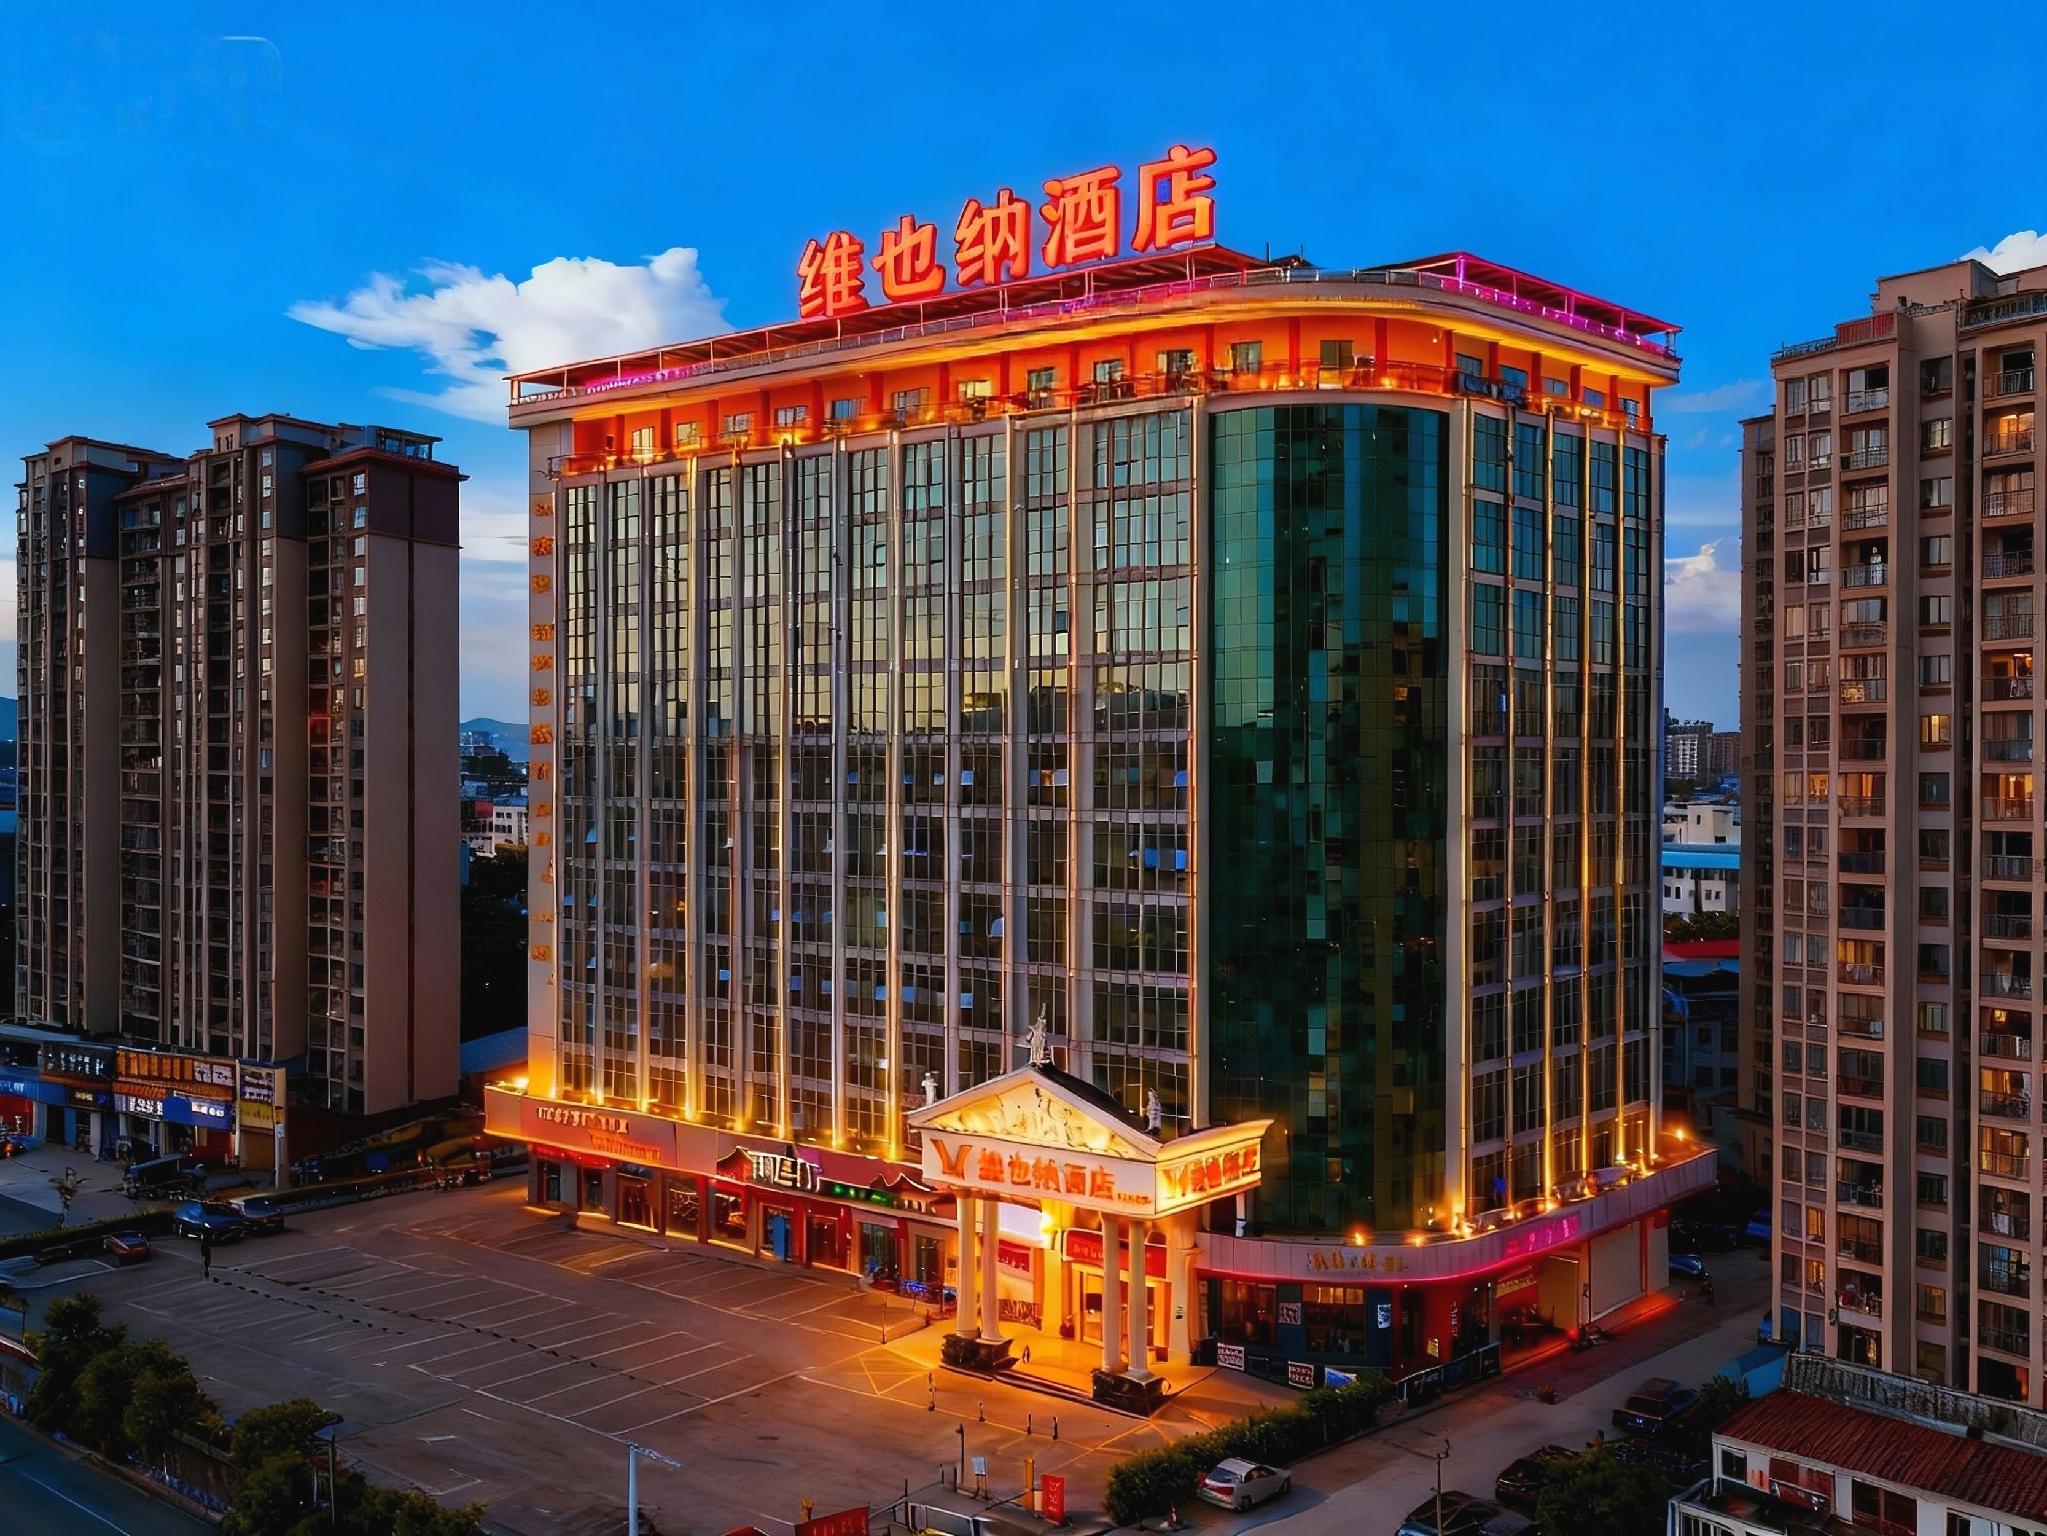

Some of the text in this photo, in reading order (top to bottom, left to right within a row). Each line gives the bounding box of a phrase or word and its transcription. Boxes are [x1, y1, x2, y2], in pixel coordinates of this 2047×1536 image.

[797, 145, 1217, 318] 维也纳酒店
